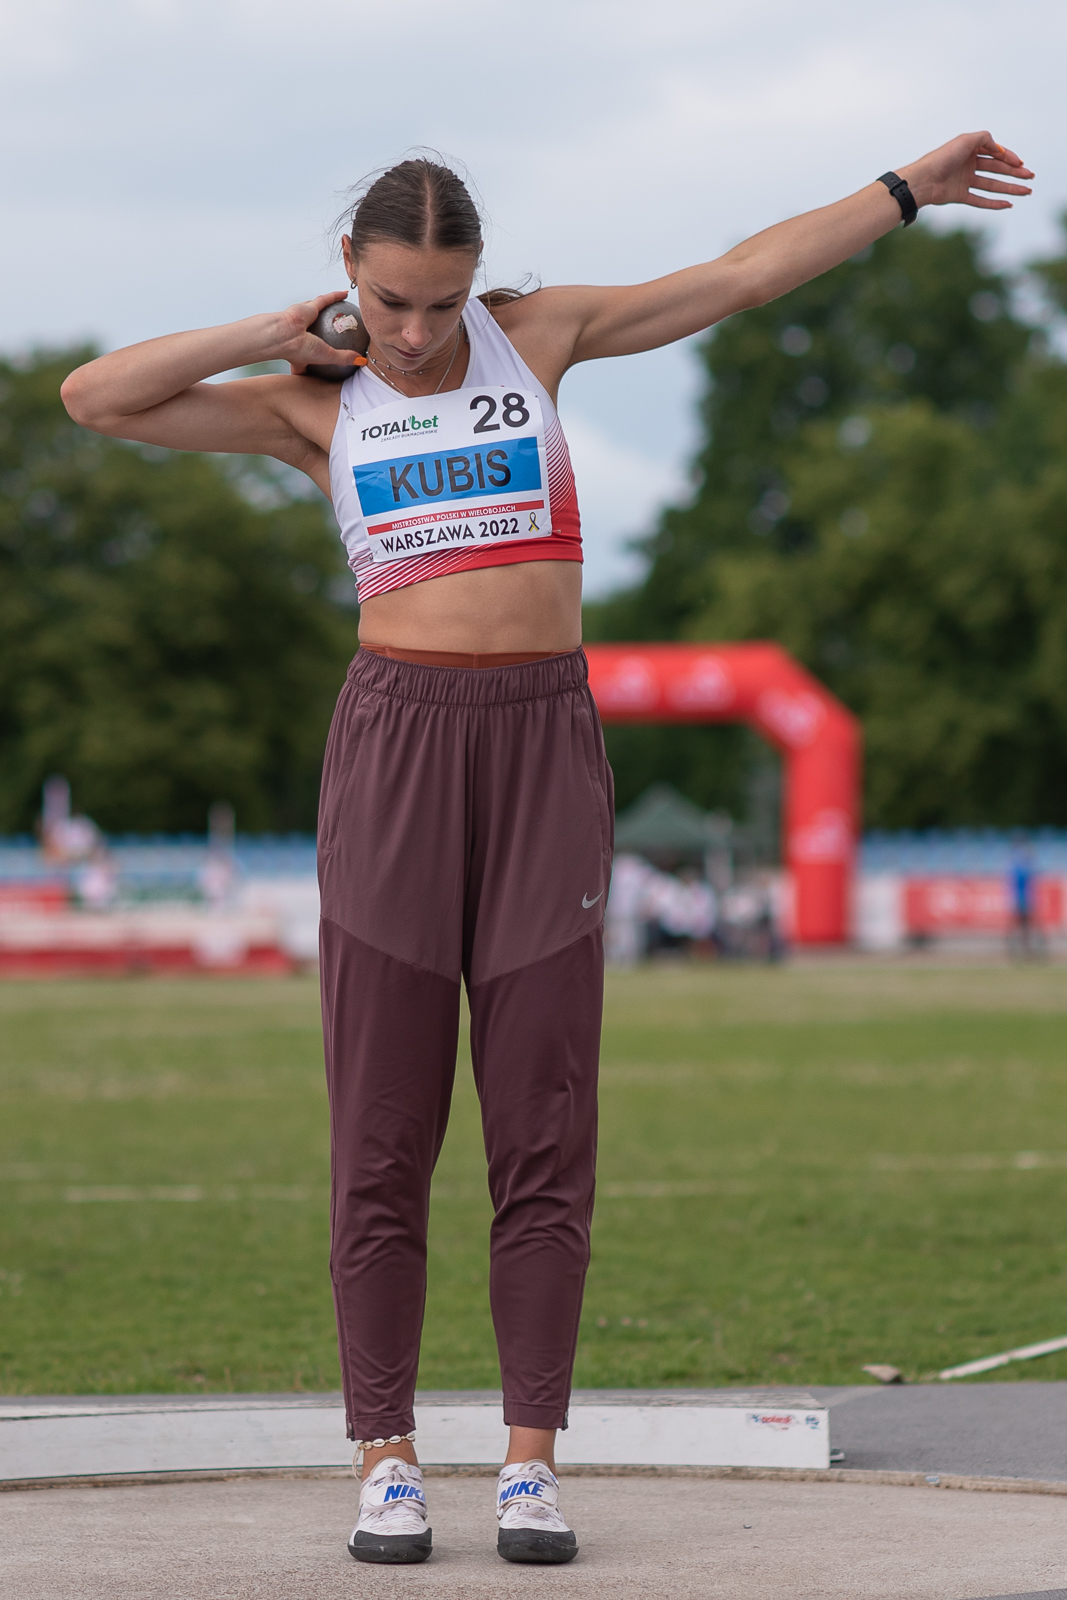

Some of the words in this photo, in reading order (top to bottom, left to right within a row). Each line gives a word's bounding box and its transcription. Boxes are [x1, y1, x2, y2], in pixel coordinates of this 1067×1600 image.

[469, 392, 530, 434] 28
[389, 450, 511, 502] KUBIS
[392, 516, 435, 530] MISTRZOSTWA
[436, 513, 459, 522] POLSKI
[468, 505, 516, 517] WIELOBOJACH
[380, 523, 475, 554] WARSZAWA
[479, 518, 520, 538] 2022
[499, 1481, 546, 1505] NIKE
